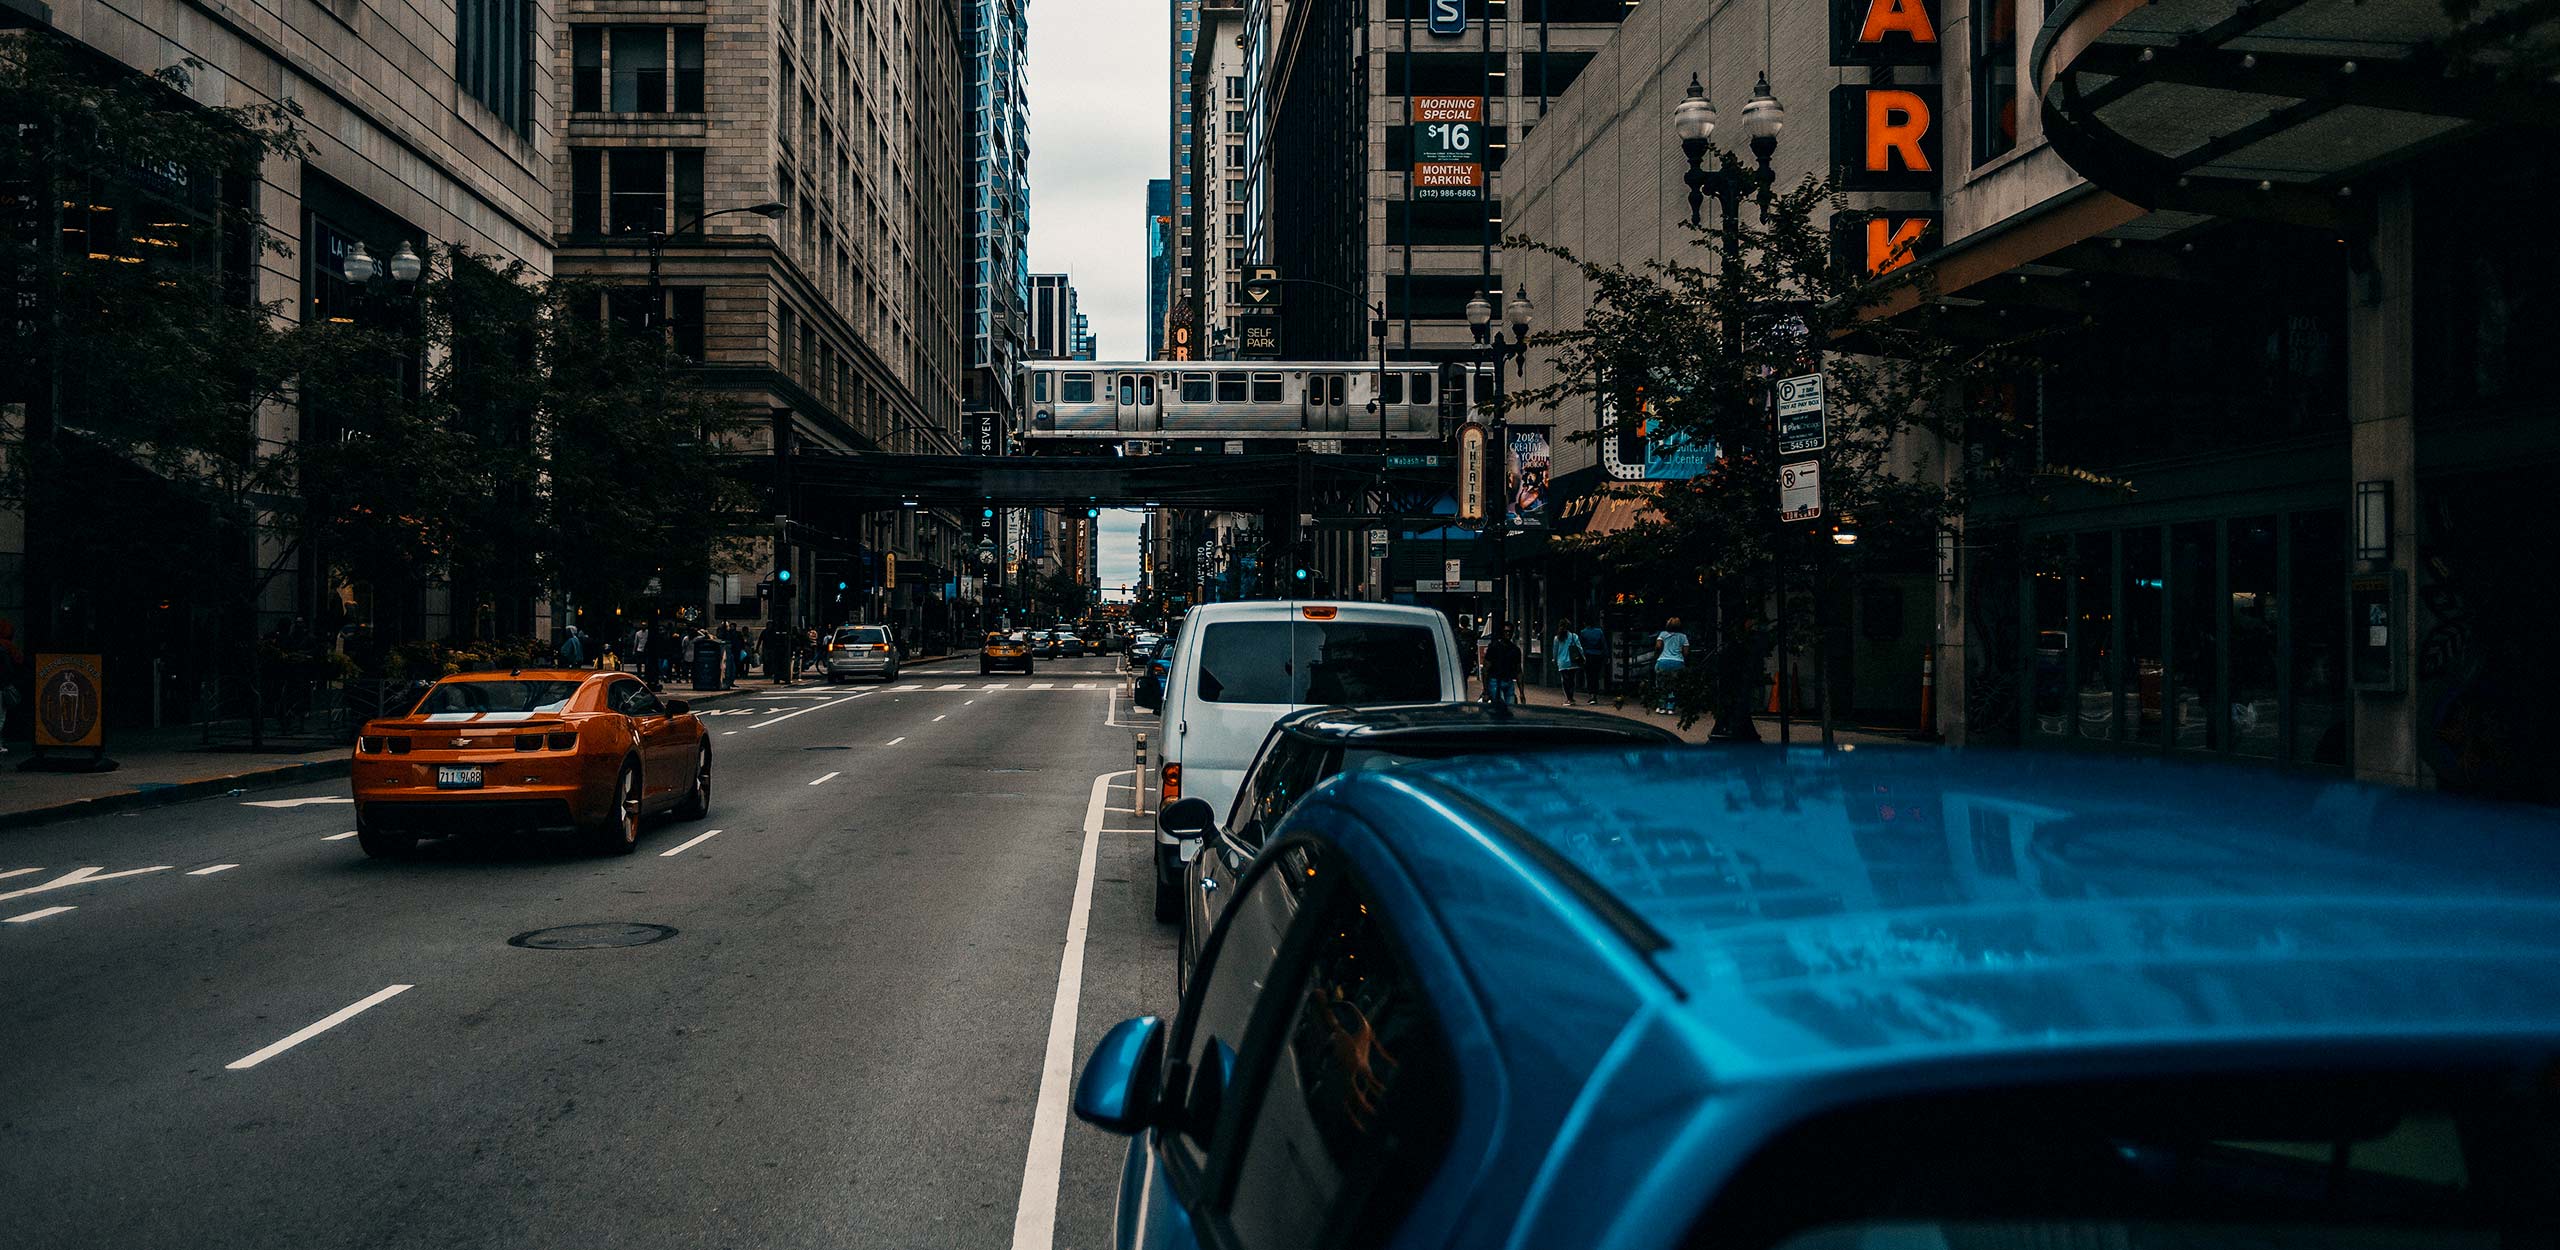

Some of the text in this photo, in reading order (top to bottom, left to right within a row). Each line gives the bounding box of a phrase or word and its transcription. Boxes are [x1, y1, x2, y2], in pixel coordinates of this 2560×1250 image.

[1420, 99, 1475, 109] MORNING
[1423, 109, 1472, 119] SPECIAL
[1427, 123, 1470, 151] $16
[1422, 165, 1473, 175] MONTHLY
[1424, 175, 1472, 185] PARKING
[1419, 189, 1438, 198] (312)
[1247, 327, 1272, 338] SELF
[1246, 338, 1275, 348] PARK
[981, 417, 992, 451] SEVEN
[1790, 439, 1818, 450] 545 519
[1393, 457, 1419, 465] Wabash
[1675, 454, 1704, 465] center
[1469, 440, 1477, 514] THEATRE
[440, 771, 481, 783] 711 9488
